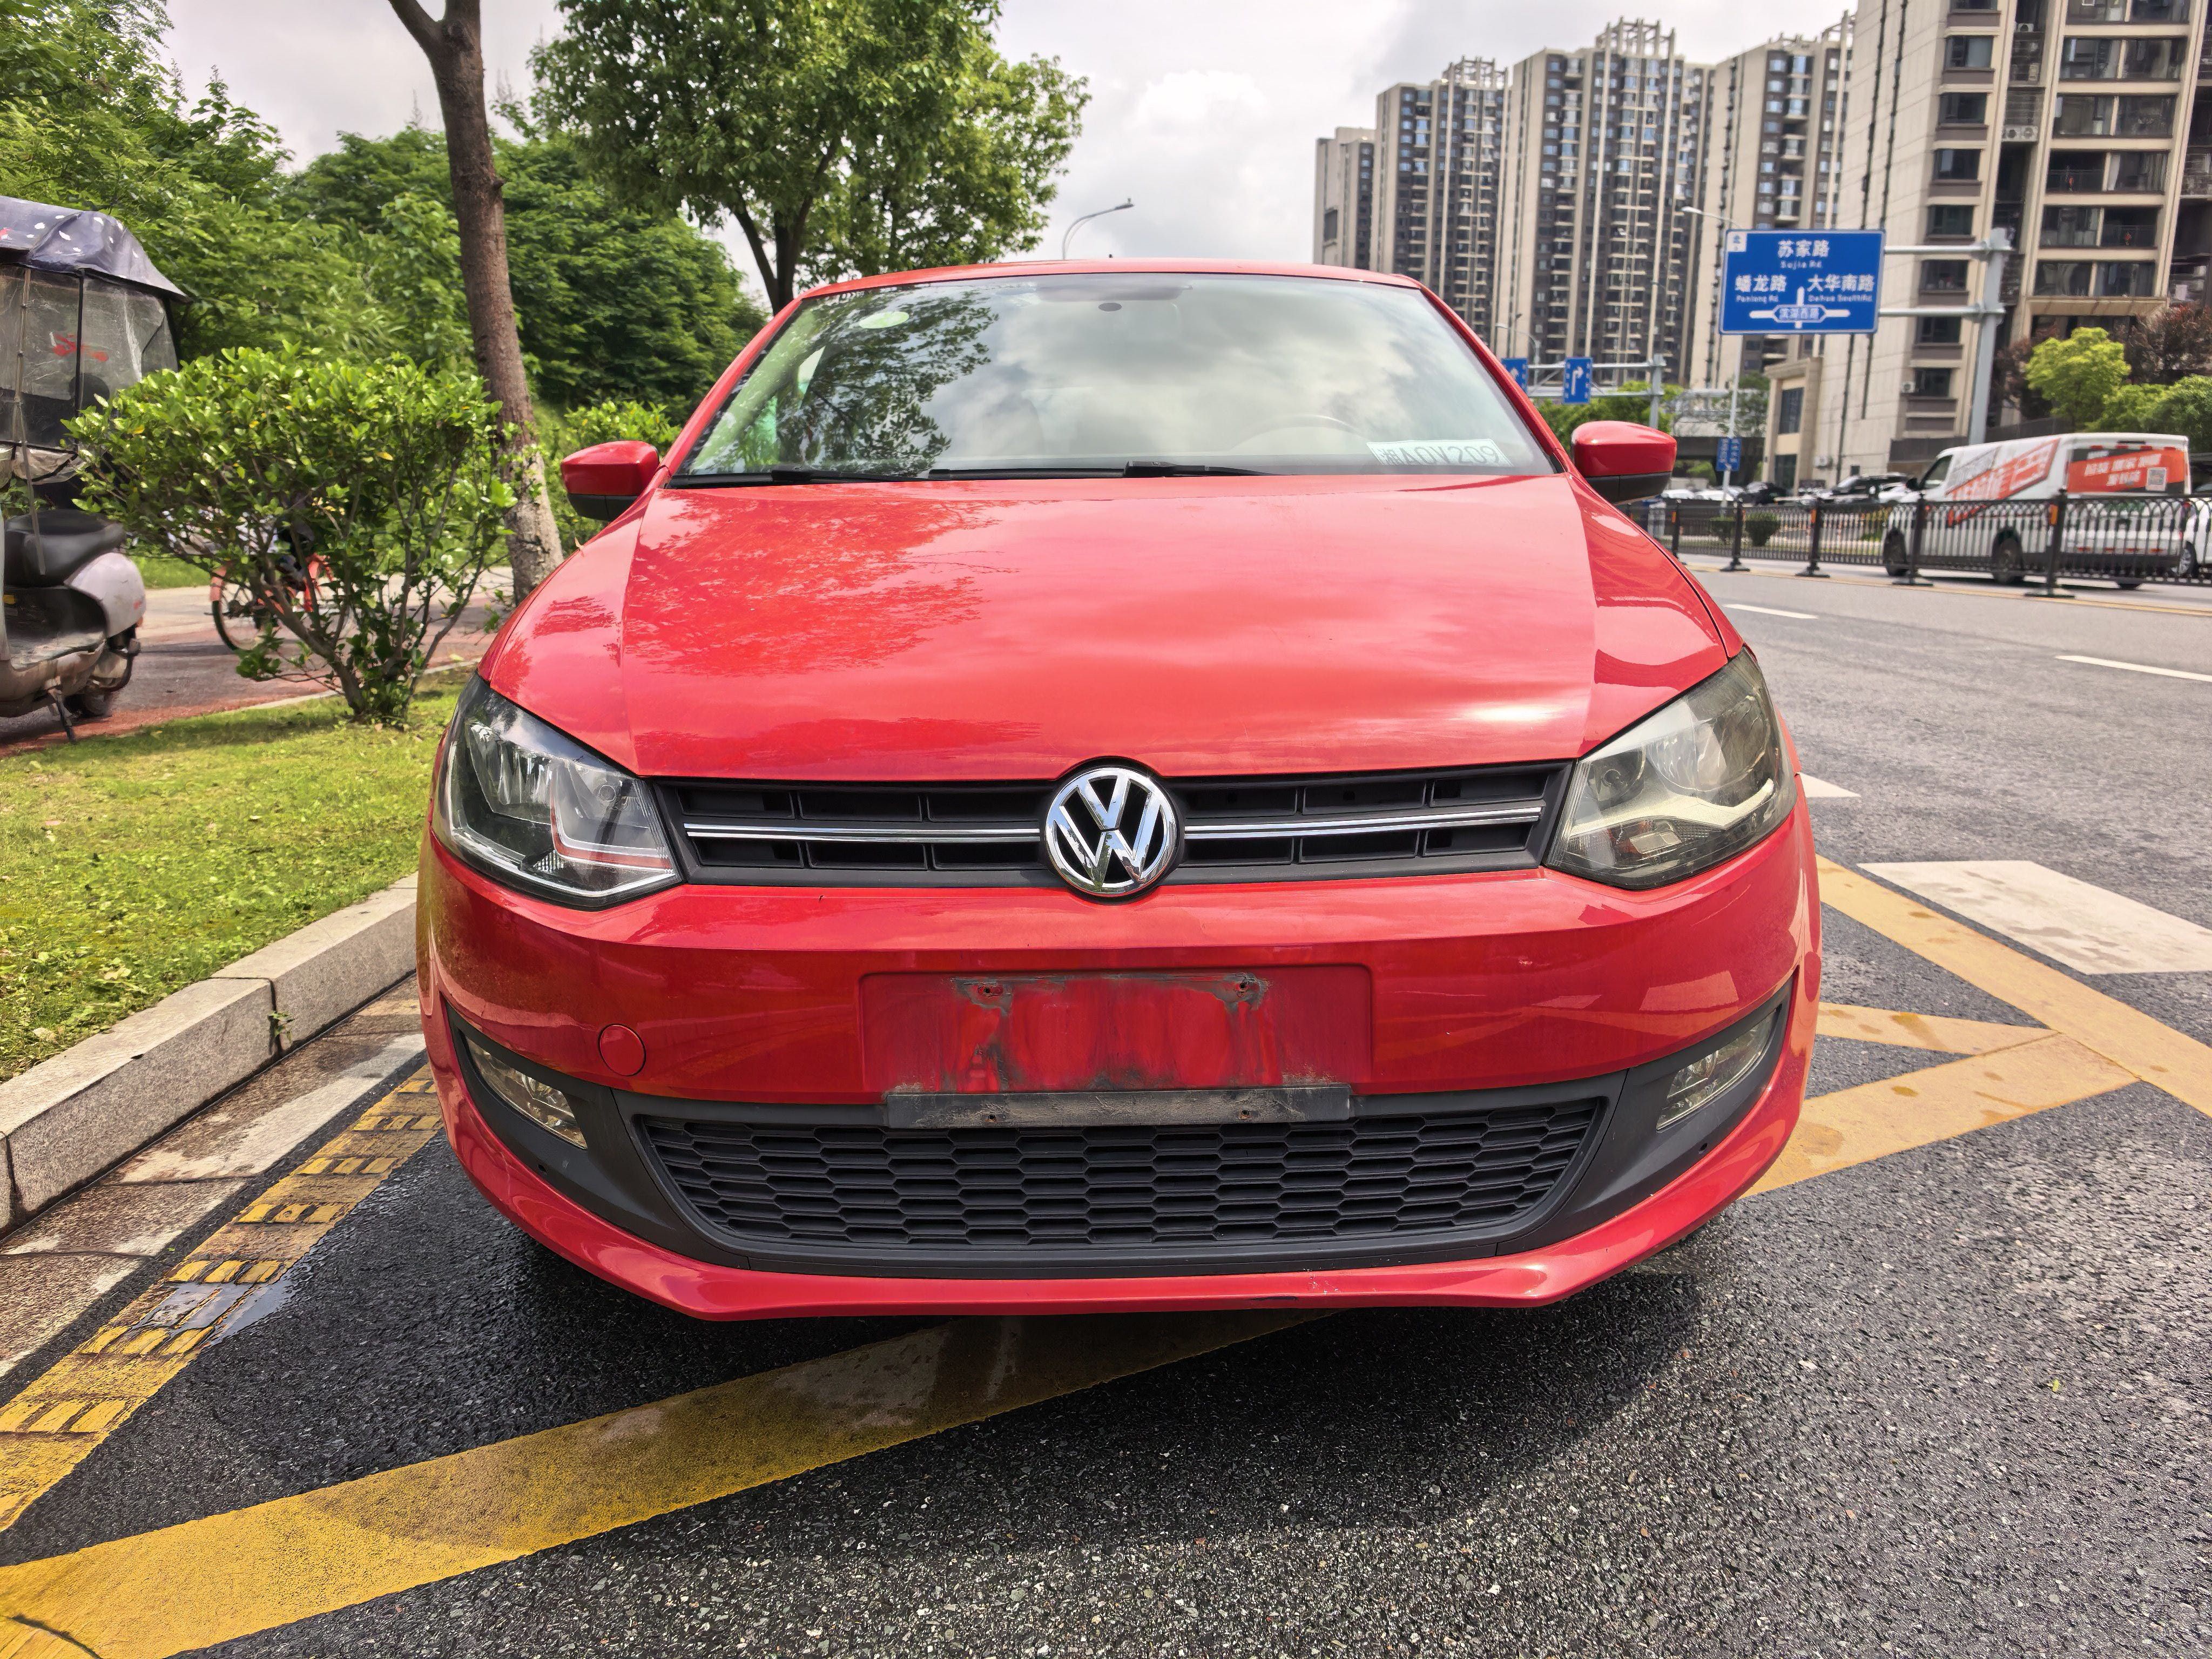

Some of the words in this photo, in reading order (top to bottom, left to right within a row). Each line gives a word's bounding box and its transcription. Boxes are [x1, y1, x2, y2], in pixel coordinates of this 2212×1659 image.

[1778, 239, 1830, 258] 苏家路
[1735, 274, 1787, 292] 蟠龙路
[1807, 274, 1874, 292] 大华南路
[1046, 767, 1177, 895] VW
